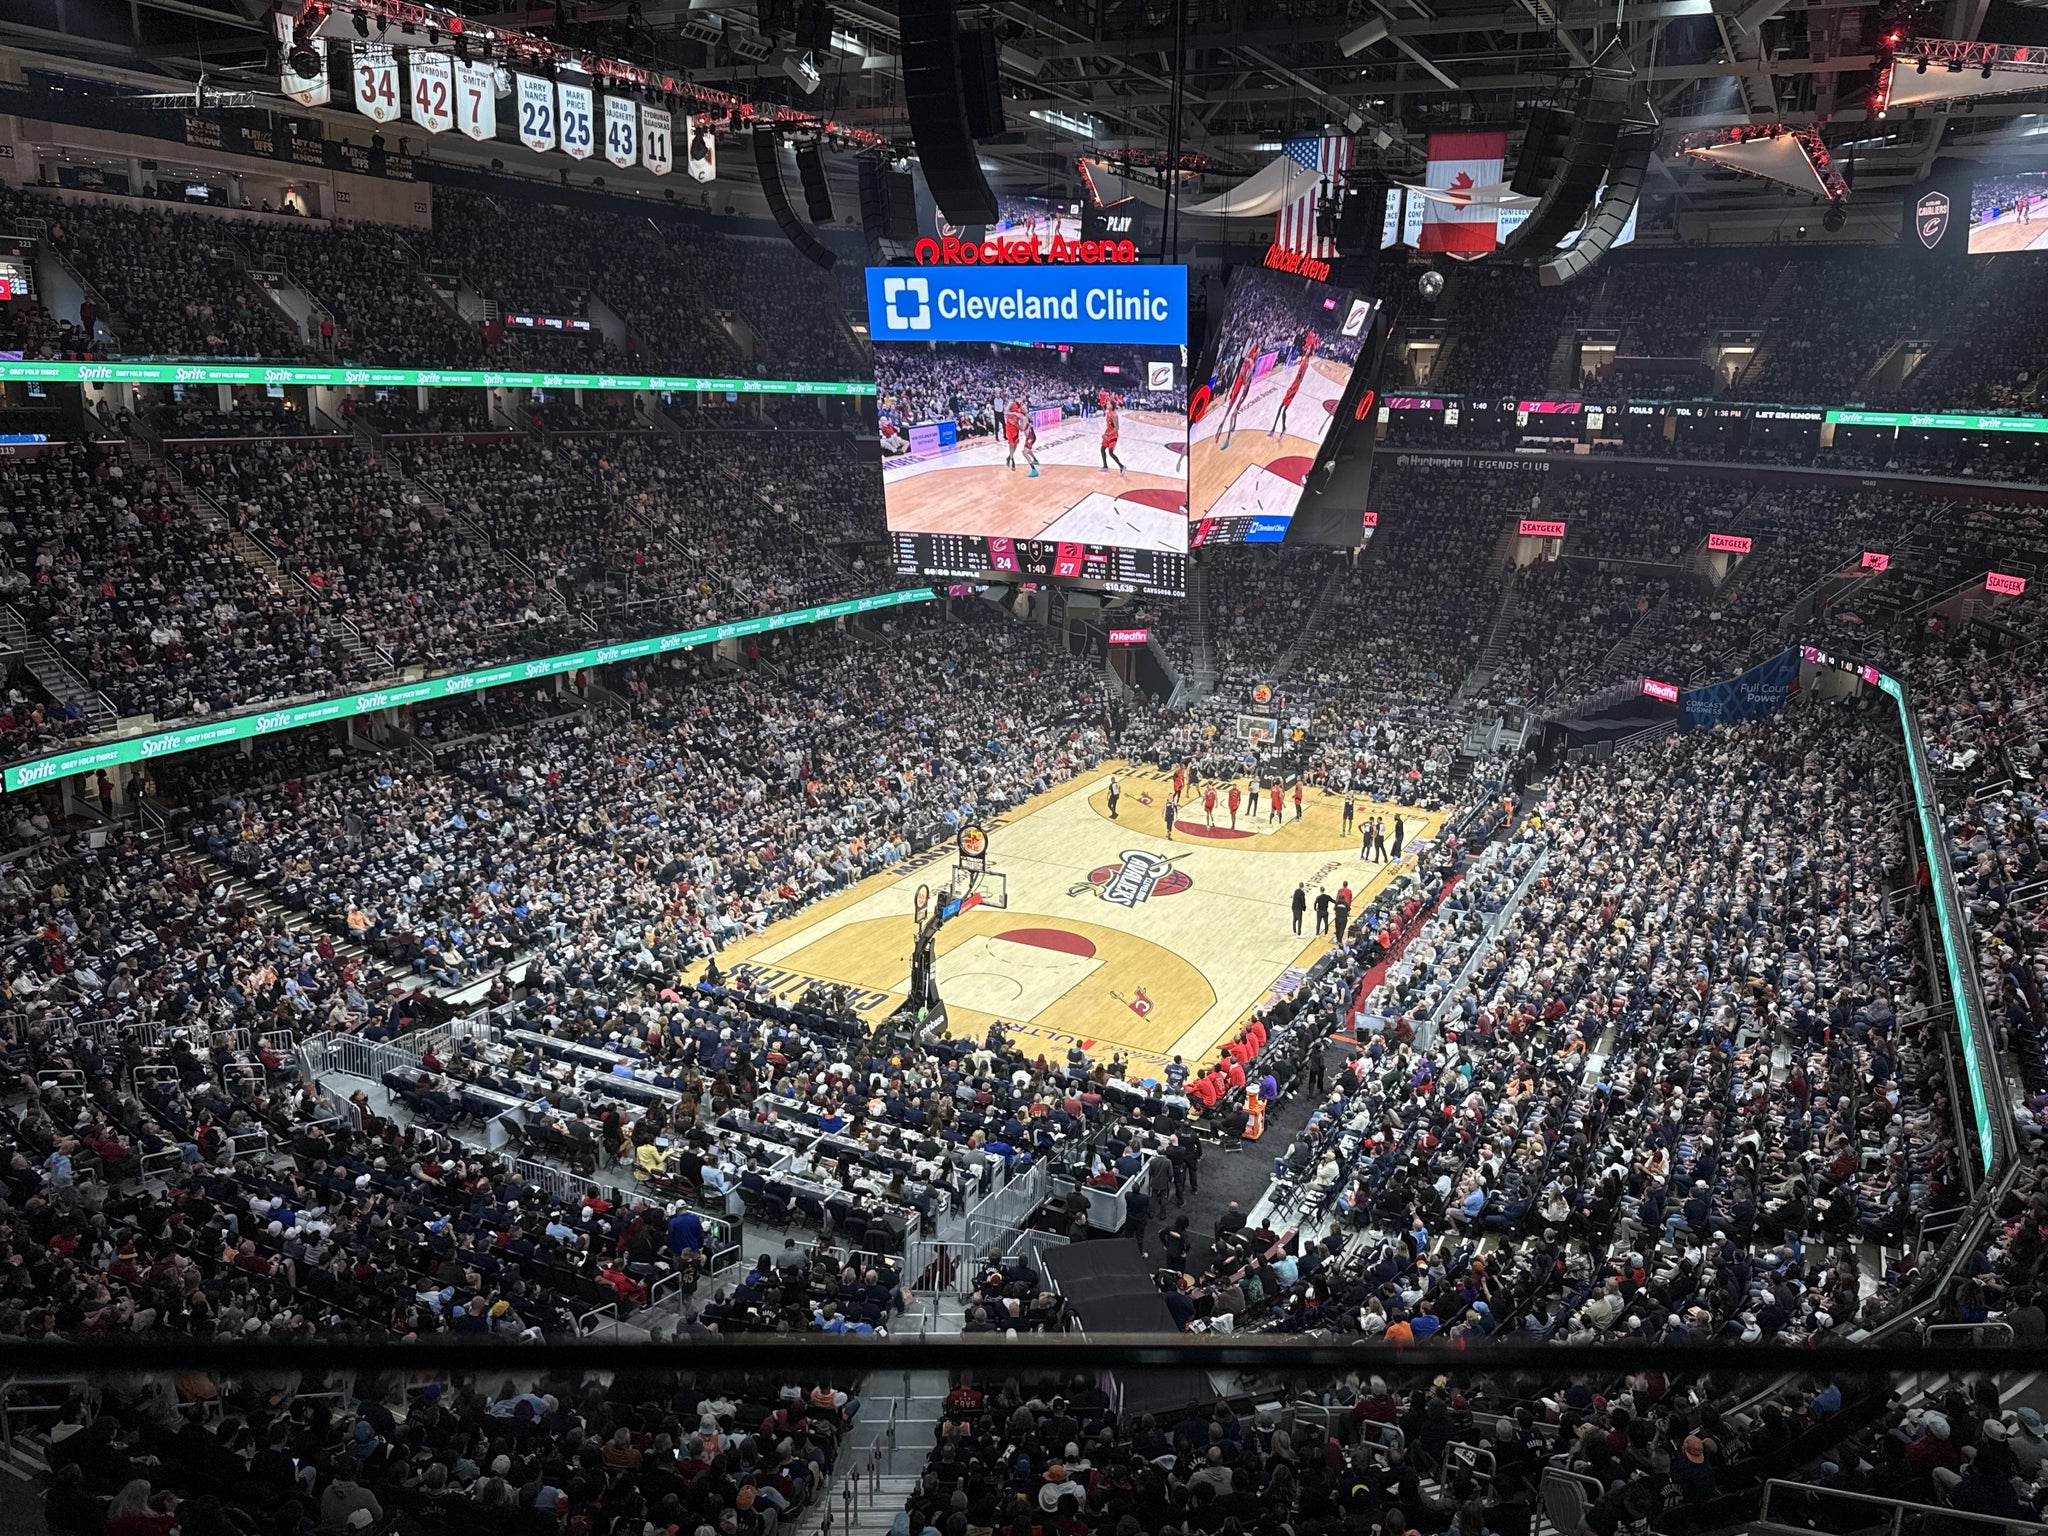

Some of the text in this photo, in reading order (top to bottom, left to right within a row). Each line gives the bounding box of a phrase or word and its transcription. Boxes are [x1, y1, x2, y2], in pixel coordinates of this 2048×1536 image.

[361, 66, 395, 107] 34
[462, 75, 487, 88] SMITH
[524, 80, 546, 93] LARRY
[416, 78, 448, 117] 42
[524, 90, 548, 102] NANCE
[566, 90, 585, 101] MARK
[468, 89, 482, 123] 7
[566, 100, 586, 111] PRICE
[611, 101, 628, 111] BRAD
[523, 102, 551, 138] 22
[643, 110, 670, 123] ZYDRUNAS
[563, 111, 590, 146] 25
[609, 122, 632, 154] 43
[648, 131, 667, 162] 11
[292, 152, 324, 165] KNOW.
[337, 193, 349, 201] 224
[1919, 205, 1947, 216] CAVALIERS
[1106, 216, 1132, 232] PLAY
[943, 234, 1136, 264] Rocket Arena
[1300, 254, 1331, 281] Arena
[937, 288, 1168, 321] Cleveland Clinic
[78, 366, 112, 379] Sprite
[175, 367, 206, 381] Sprite
[264, 369, 292, 382] Sprite
[345, 371, 369, 384] Sprite
[417, 372, 440, 384] Sprite
[483, 374, 504, 385] Sprite
[543, 375, 563, 386] Sprite
[598, 377, 616, 388] Sprite
[1420, 400, 1431, 409] 24
[1472, 402, 1487, 410] 1:40
[1502, 402, 1515, 412] 1Q
[1529, 403, 1540, 412] 27
[1584, 405, 1602, 414] FG%
[1606, 406, 1617, 414] 63
[1629, 406, 1653, 415] FOULS
[1659, 407, 1665, 415] 4
[1677, 408, 1691, 416] TOL
[1696, 409, 1703, 417] 6
[1714, 410, 1729, 418] 1:36
[1730, 410, 1742, 418] PM
[1755, 410, 1773, 419] LET
[1774, 411, 1789, 420] EM
[1789, 412, 1822, 421] KNOW.
[1838, 412, 1862, 423] Sprite
[1909, 415, 1935, 426] Sprite
[1977, 417, 2000, 429] Sprite
[1410, 455, 1550, 472] Huntington LEGENDS CLUB
[1521, 524, 1562, 533] SEATGEEK
[1016, 543, 1027, 551] 1Q
[1710, 537, 1749, 549] SEATGEEK
[997, 557, 1075, 574] 24 1:40 27
[951, 570, 980, 578] RAFFLE
[1988, 575, 2023, 592] SEATGEEK
[768, 616, 785, 629] Sprite
[716, 625, 735, 639] Sprite
[1119, 631, 1146, 642] Redfin
[660, 636, 680, 650] Sprite
[596, 649, 619, 664] Sprite
[1817, 652, 1826, 663] 24
[1840, 660, 1853, 672] 1:40
[525, 661, 550, 677] Sprite
[446, 676, 473, 693] Sprite
[1740, 683, 1789, 694] Full Court
[1652, 685, 1677, 699] Redfin
[1747, 694, 1780, 703] Power
[356, 693, 387, 712] Sprite
[1686, 700, 1723, 709] COMCAST
[1686, 707, 1722, 716] BUSINESS
[256, 713, 290, 734] Sprite
[141, 735, 181, 758] Sprite
[17, 761, 56, 787] Sprite
[61, 759, 77, 770] OBEY
[920, 1014, 946, 1039] coinbase
